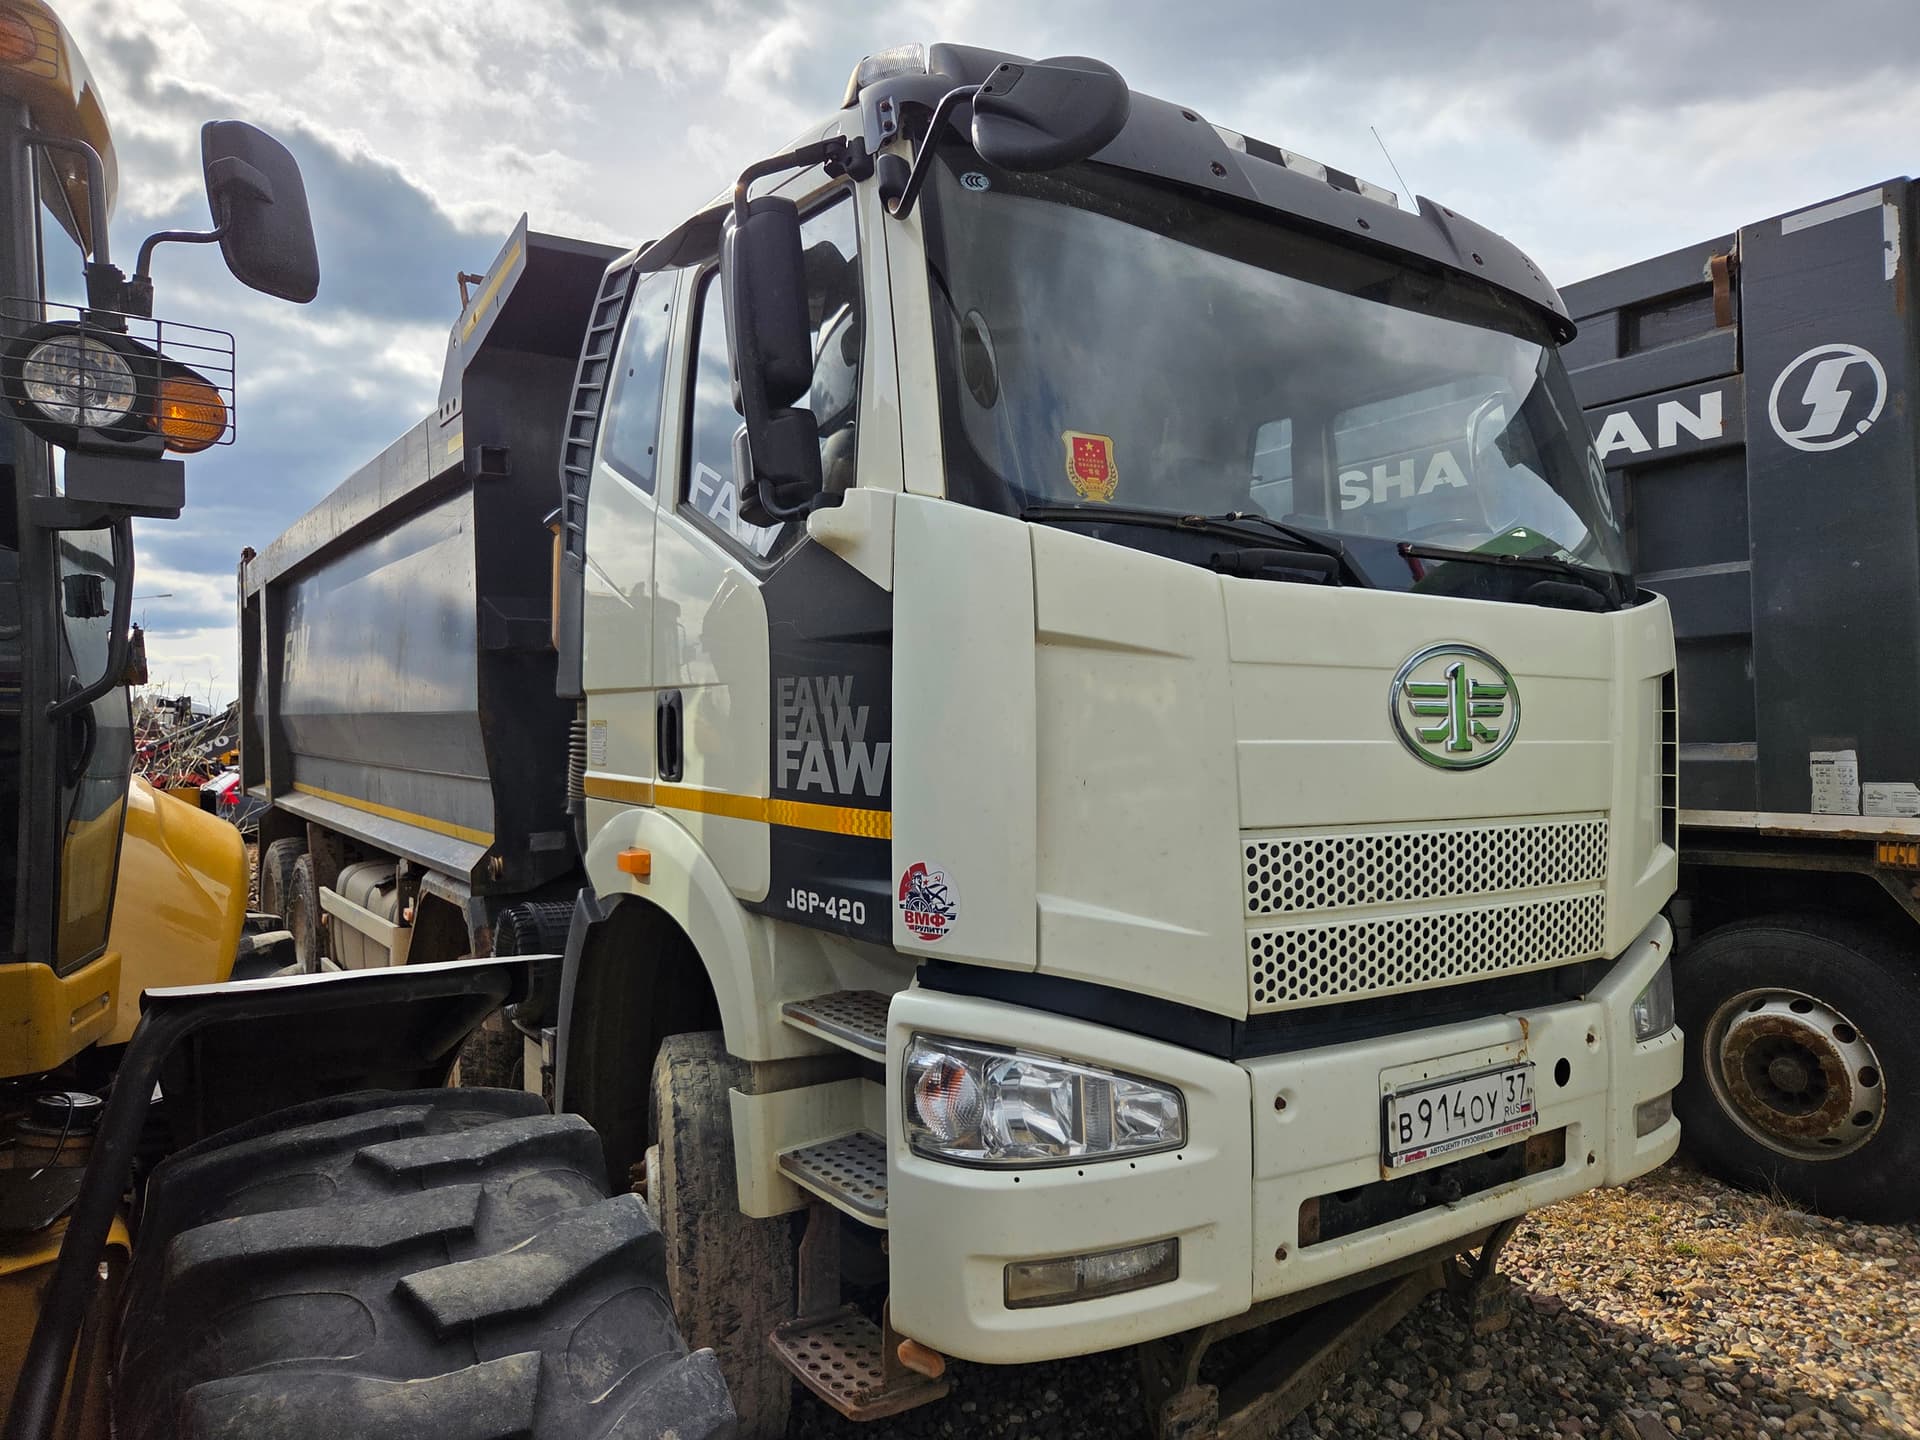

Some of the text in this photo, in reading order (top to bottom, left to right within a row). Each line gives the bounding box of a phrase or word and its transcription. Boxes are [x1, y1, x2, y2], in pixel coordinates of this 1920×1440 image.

[776, 739, 891, 797] FAW
[786, 887, 866, 925] J6P-420
[904, 910, 946, 928] ВМФ
[914, 924, 944, 935] РУЛИТ!
[1505, 1072, 1526, 1103] 37
[1504, 1103, 1521, 1117] RUS
